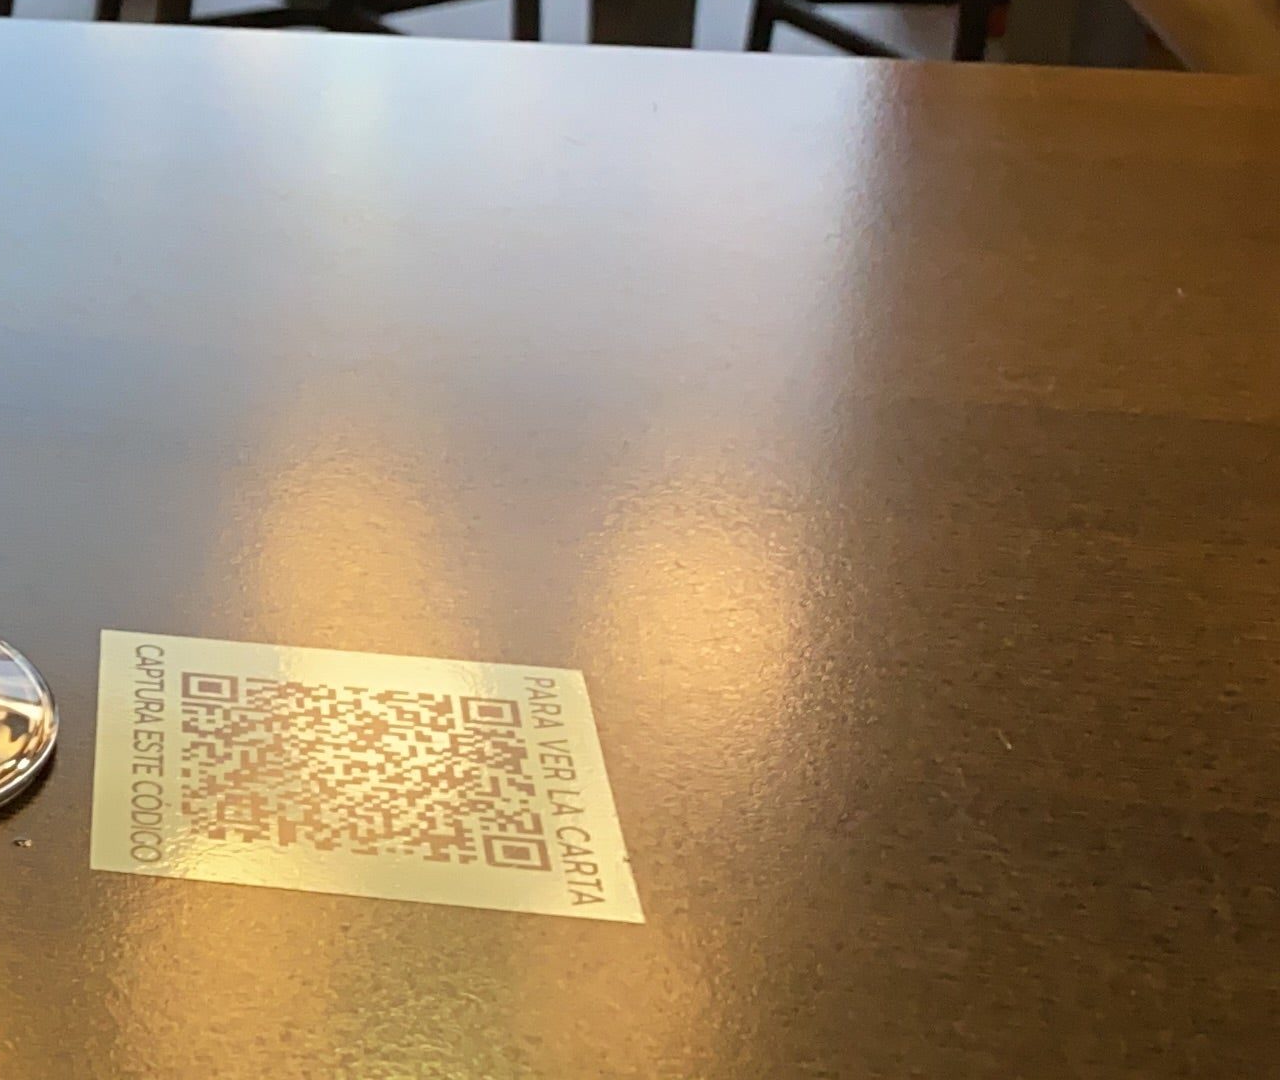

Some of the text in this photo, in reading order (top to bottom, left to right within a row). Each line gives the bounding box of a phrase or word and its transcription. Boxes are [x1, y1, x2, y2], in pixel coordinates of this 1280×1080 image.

[129, 643, 172, 864] CAPTURA ESTE CÓDIGO
[523, 675, 606, 907] PARA VER LA CARTA
